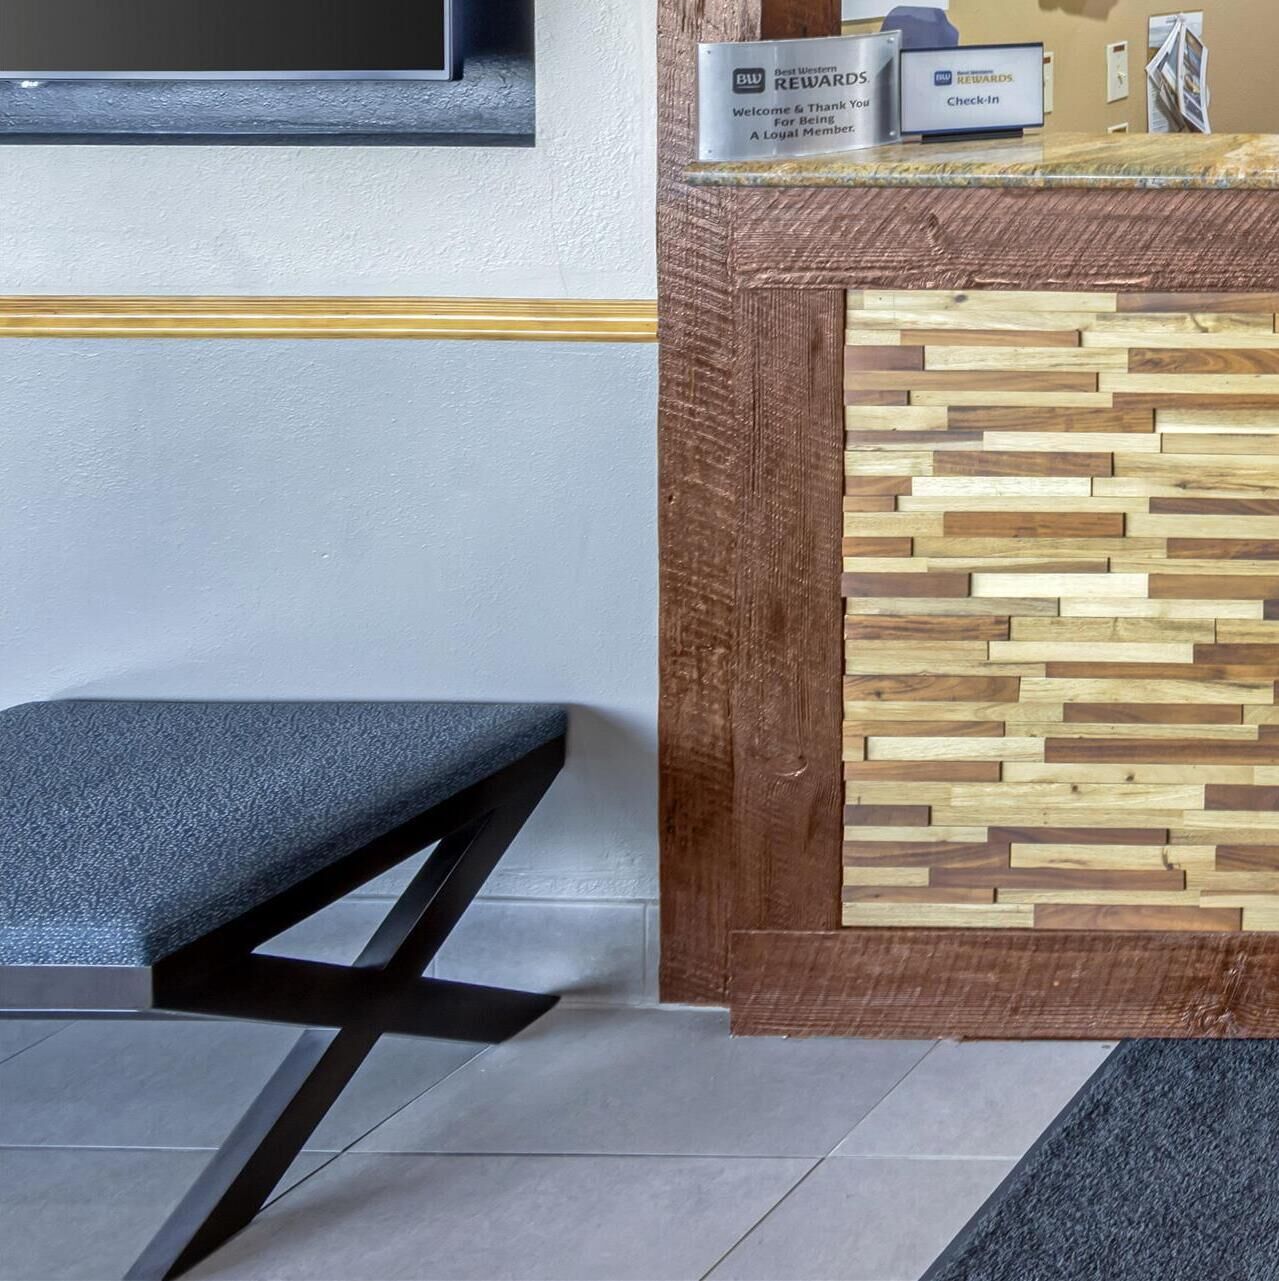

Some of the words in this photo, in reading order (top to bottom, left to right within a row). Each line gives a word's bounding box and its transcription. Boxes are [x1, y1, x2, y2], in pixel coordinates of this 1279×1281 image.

[736, 72, 762, 86] BW
[774, 68, 796, 76] Best
[798, 66, 838, 76] Western
[935, 72, 952, 82] BW
[957, 74, 1014, 86] REWARDS
[946, 94, 1000, 106] Check-In
[732, 106, 792, 118] Welcome
[794, 104, 804, 114] &
[806, 101, 846, 114] Thank
[850, 99, 870, 110] You
[774, 117, 796, 128] For
[798, 114, 834, 128] Being
[750, 132, 758, 141] A
[760, 128, 798, 141] Loyal
[802, 124, 856, 137] Member.
